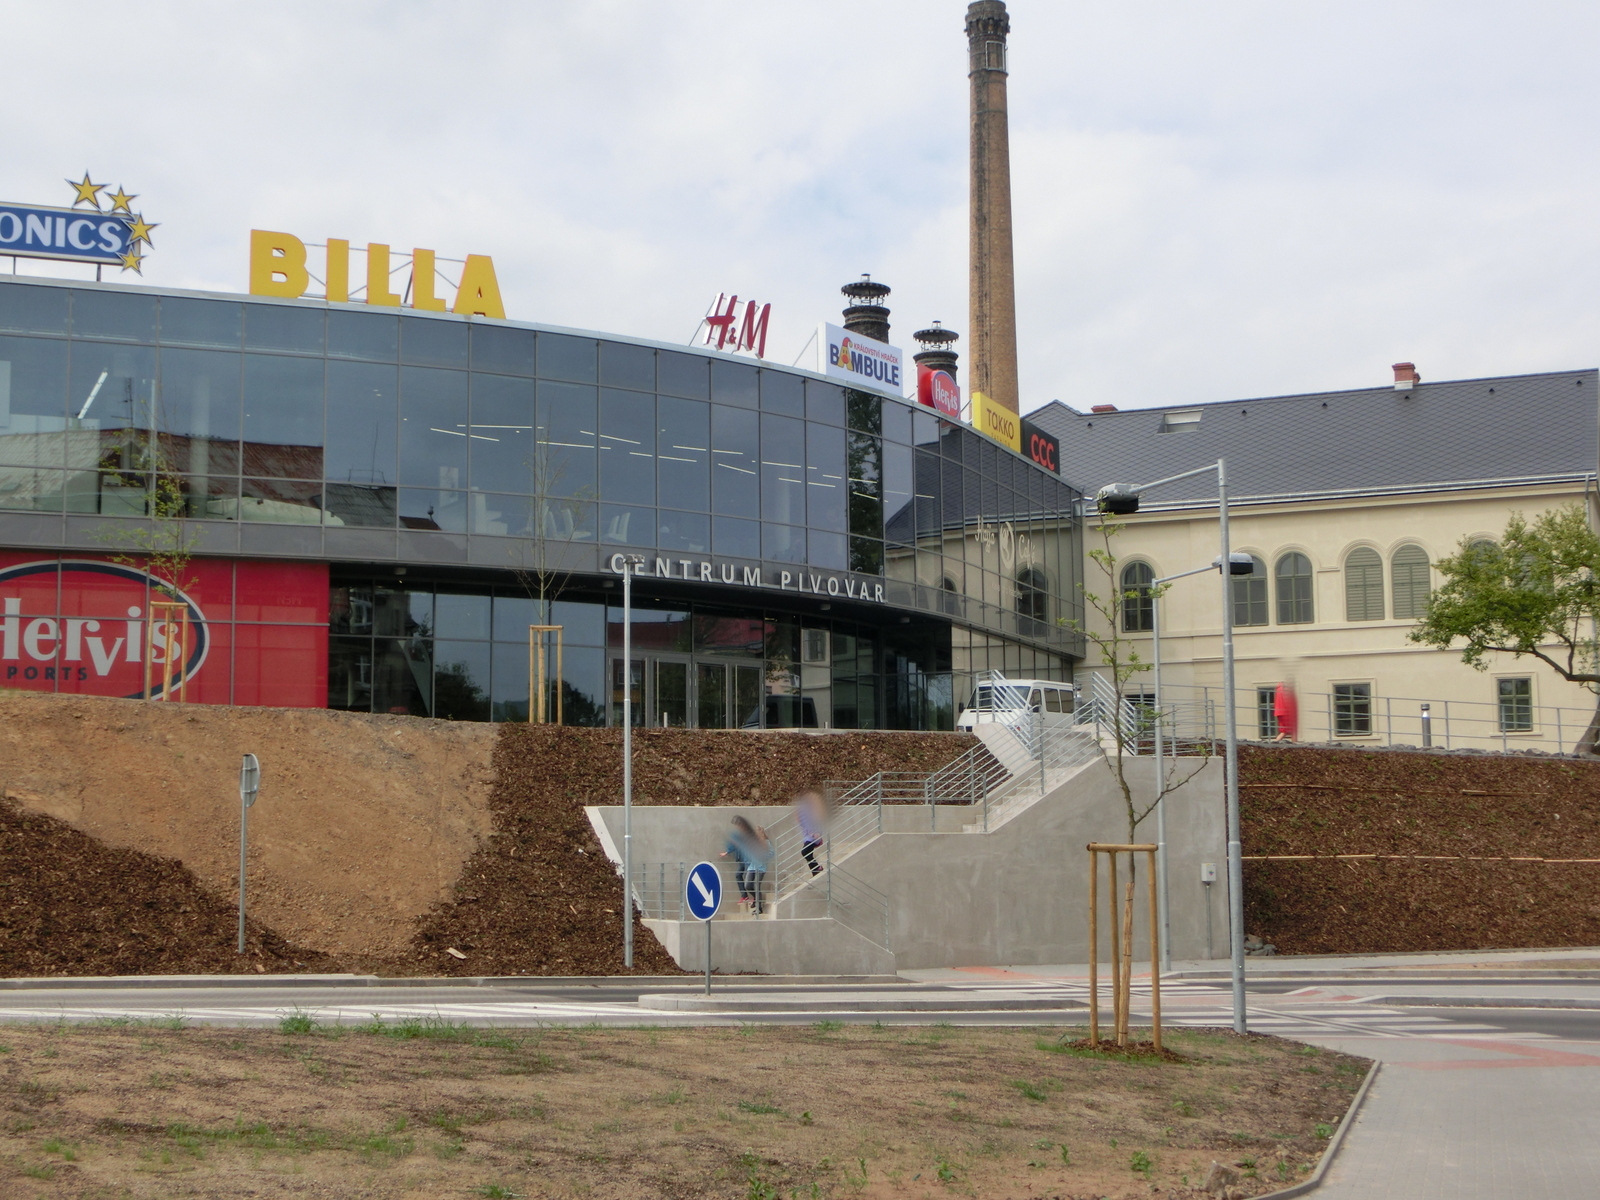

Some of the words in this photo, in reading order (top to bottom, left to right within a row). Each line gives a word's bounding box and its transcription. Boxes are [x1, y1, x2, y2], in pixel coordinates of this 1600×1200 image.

[0, 212, 122, 252] ONICS
[248, 229, 507, 319] BILLA
[704, 292, 771, 359] H&M
[830, 341, 899, 387] BAMBULE
[853, 342, 880, 358] KRÁLOVSTVÍ
[881, 350, 898, 364] HRAČEK
[935, 379, 958, 411] Hervis
[1031, 434, 1055, 470] CCC
[611, 553, 761, 587] CENTRUM
[781, 570, 884, 603] PIVOVAR
[0, 597, 182, 676] Hervis
